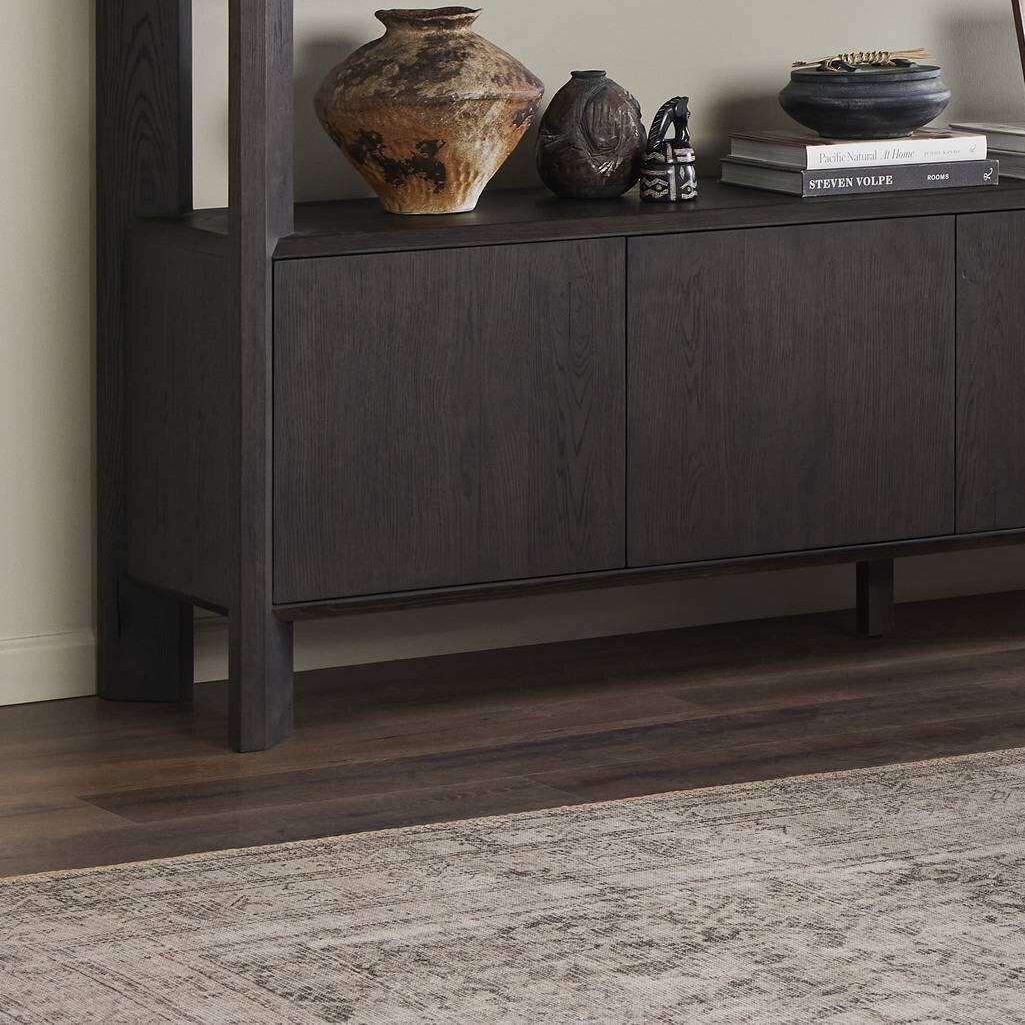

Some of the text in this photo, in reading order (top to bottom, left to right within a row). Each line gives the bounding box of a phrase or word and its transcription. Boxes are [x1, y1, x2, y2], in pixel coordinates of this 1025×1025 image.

[819, 148, 915, 164] Pacific Natural At Home
[809, 175, 893, 190] STEVEN VOLPE
[927, 173, 950, 181] ROOMS
